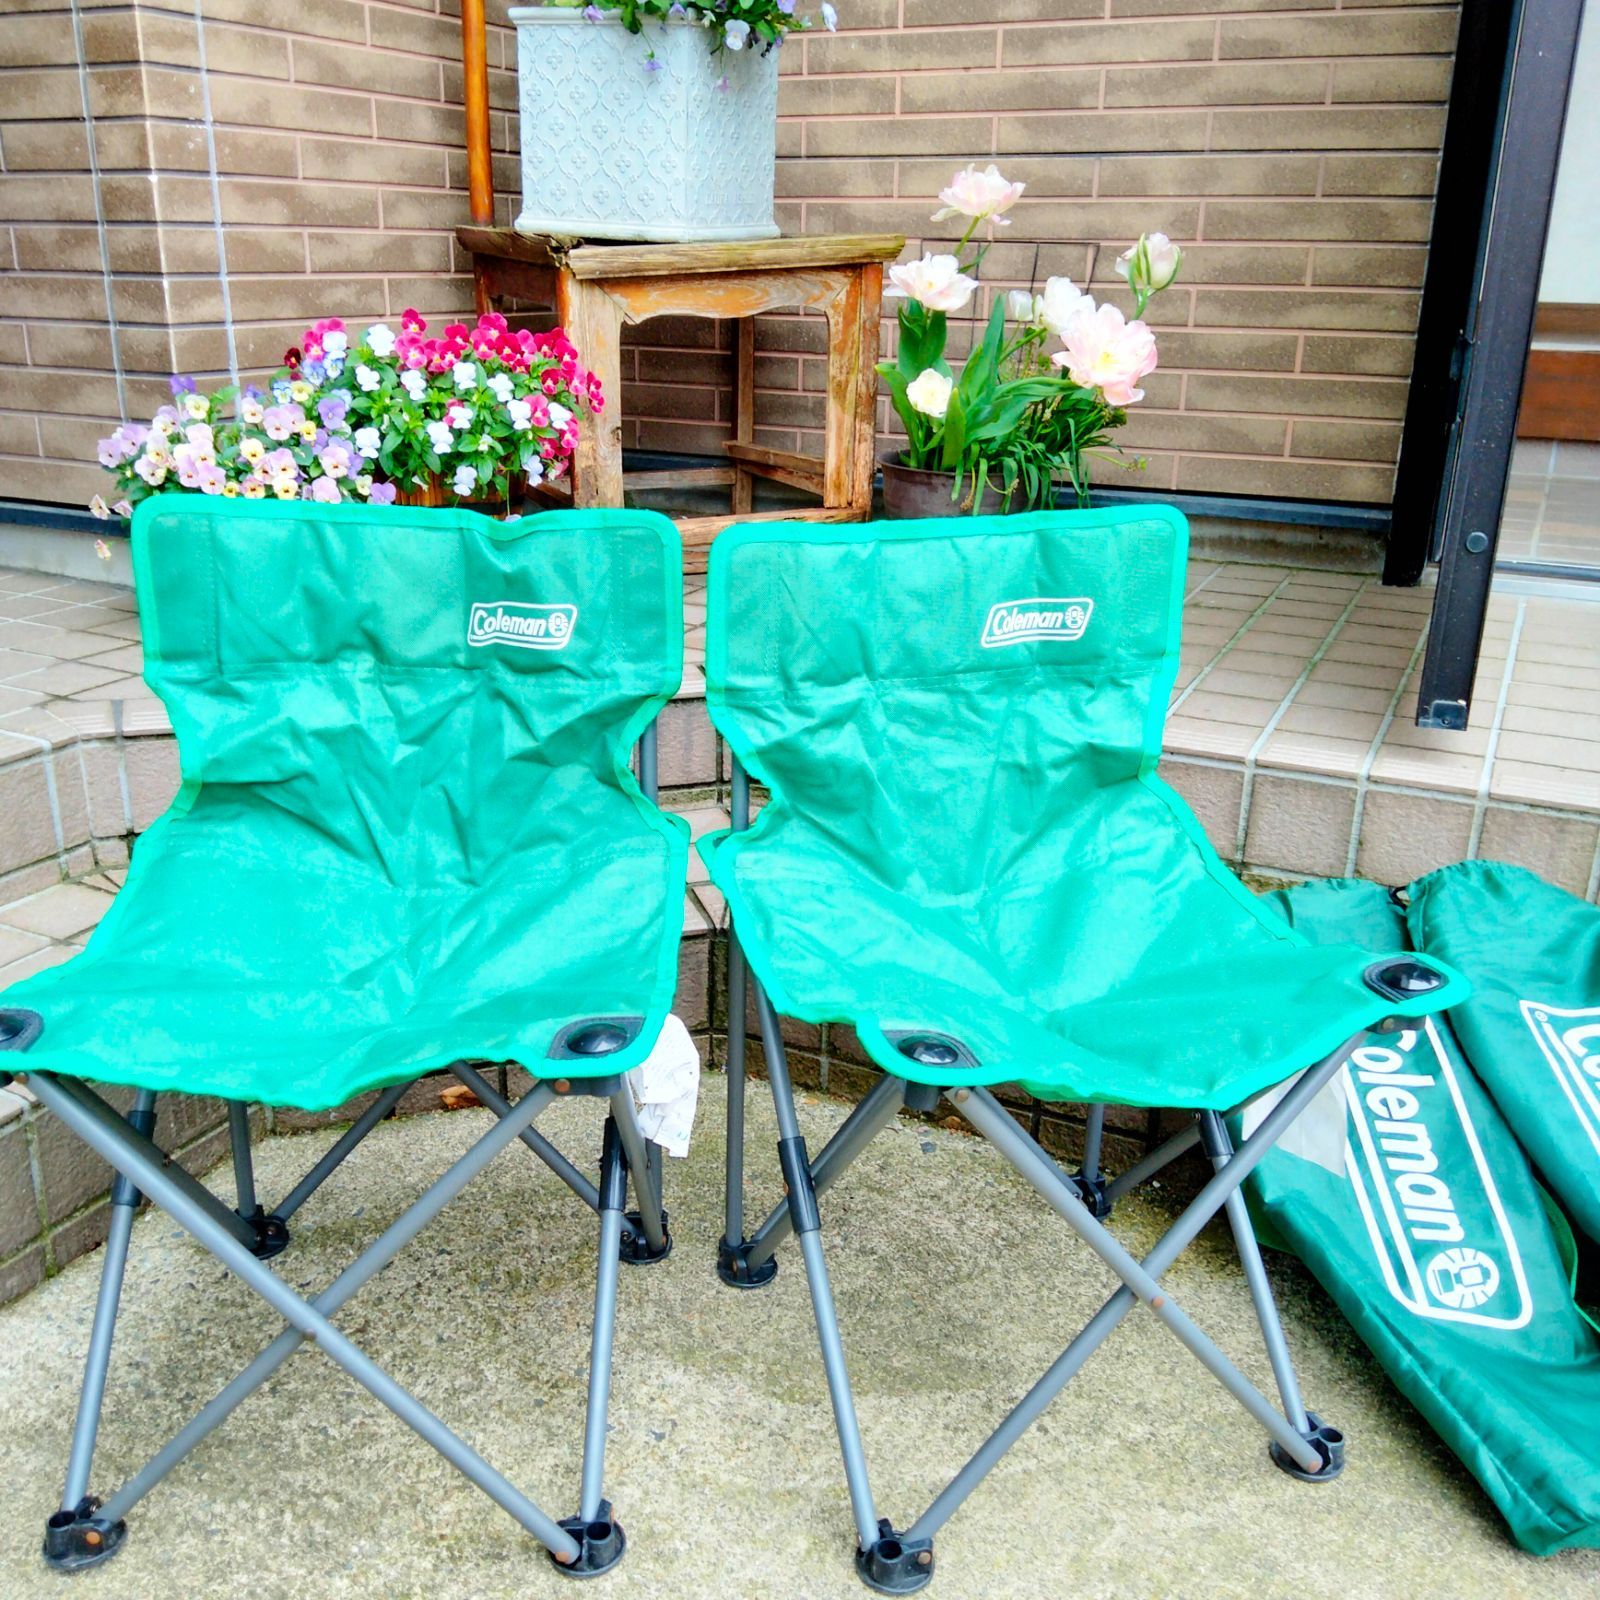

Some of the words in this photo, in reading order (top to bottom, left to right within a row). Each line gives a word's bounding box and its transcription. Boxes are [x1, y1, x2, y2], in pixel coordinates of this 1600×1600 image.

[473, 607, 547, 636] Coleman
[993, 607, 1064, 635] Coleman
[1350, 1029, 1465, 1242] oleman
